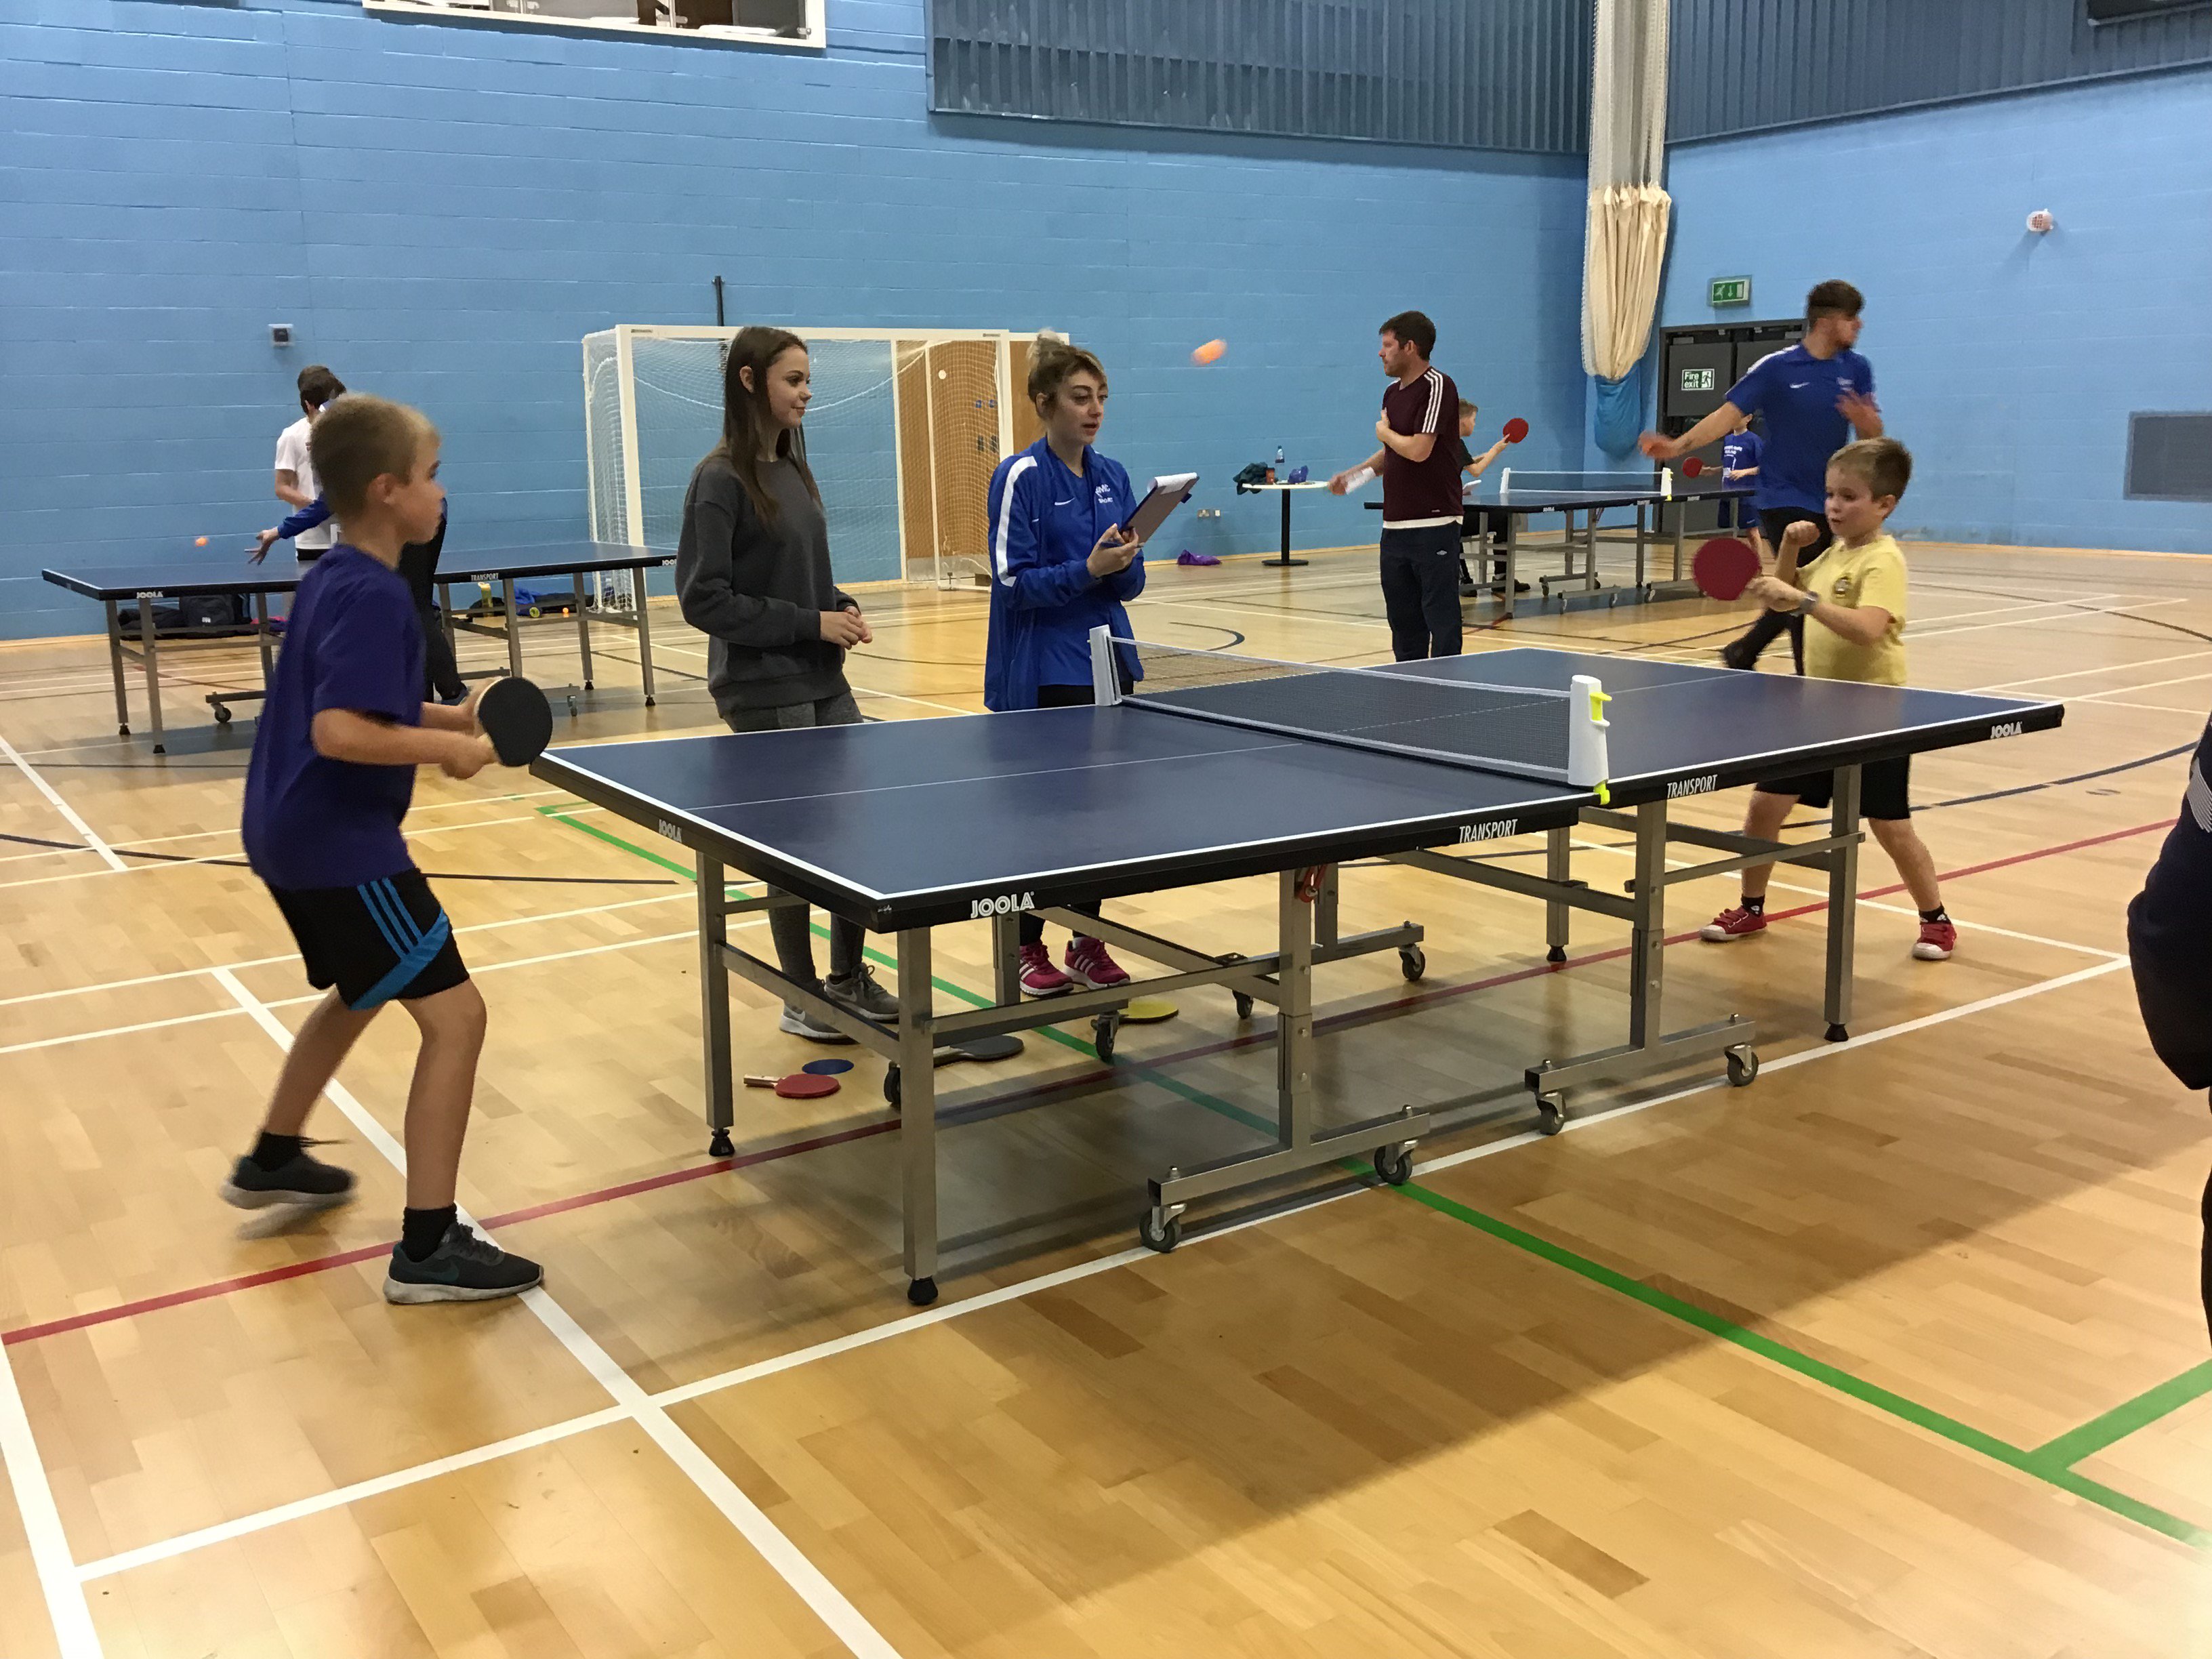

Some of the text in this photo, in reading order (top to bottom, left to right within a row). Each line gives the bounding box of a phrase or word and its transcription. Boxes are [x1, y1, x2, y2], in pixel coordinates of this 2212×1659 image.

[1684, 380, 1699, 388] exit
[1685, 371, 1699, 380] Fire
[471, 573, 499, 581] TRANSPORT
[136, 591, 163, 599] JOOLA
[1990, 721, 2022, 739] JOOLA
[1667, 774, 1718, 799] TRANSPORT
[659, 819, 682, 844] JOOLA
[1459, 818, 1518, 844] TRANSPORT
[970, 891, 1036, 919] JOOLA
